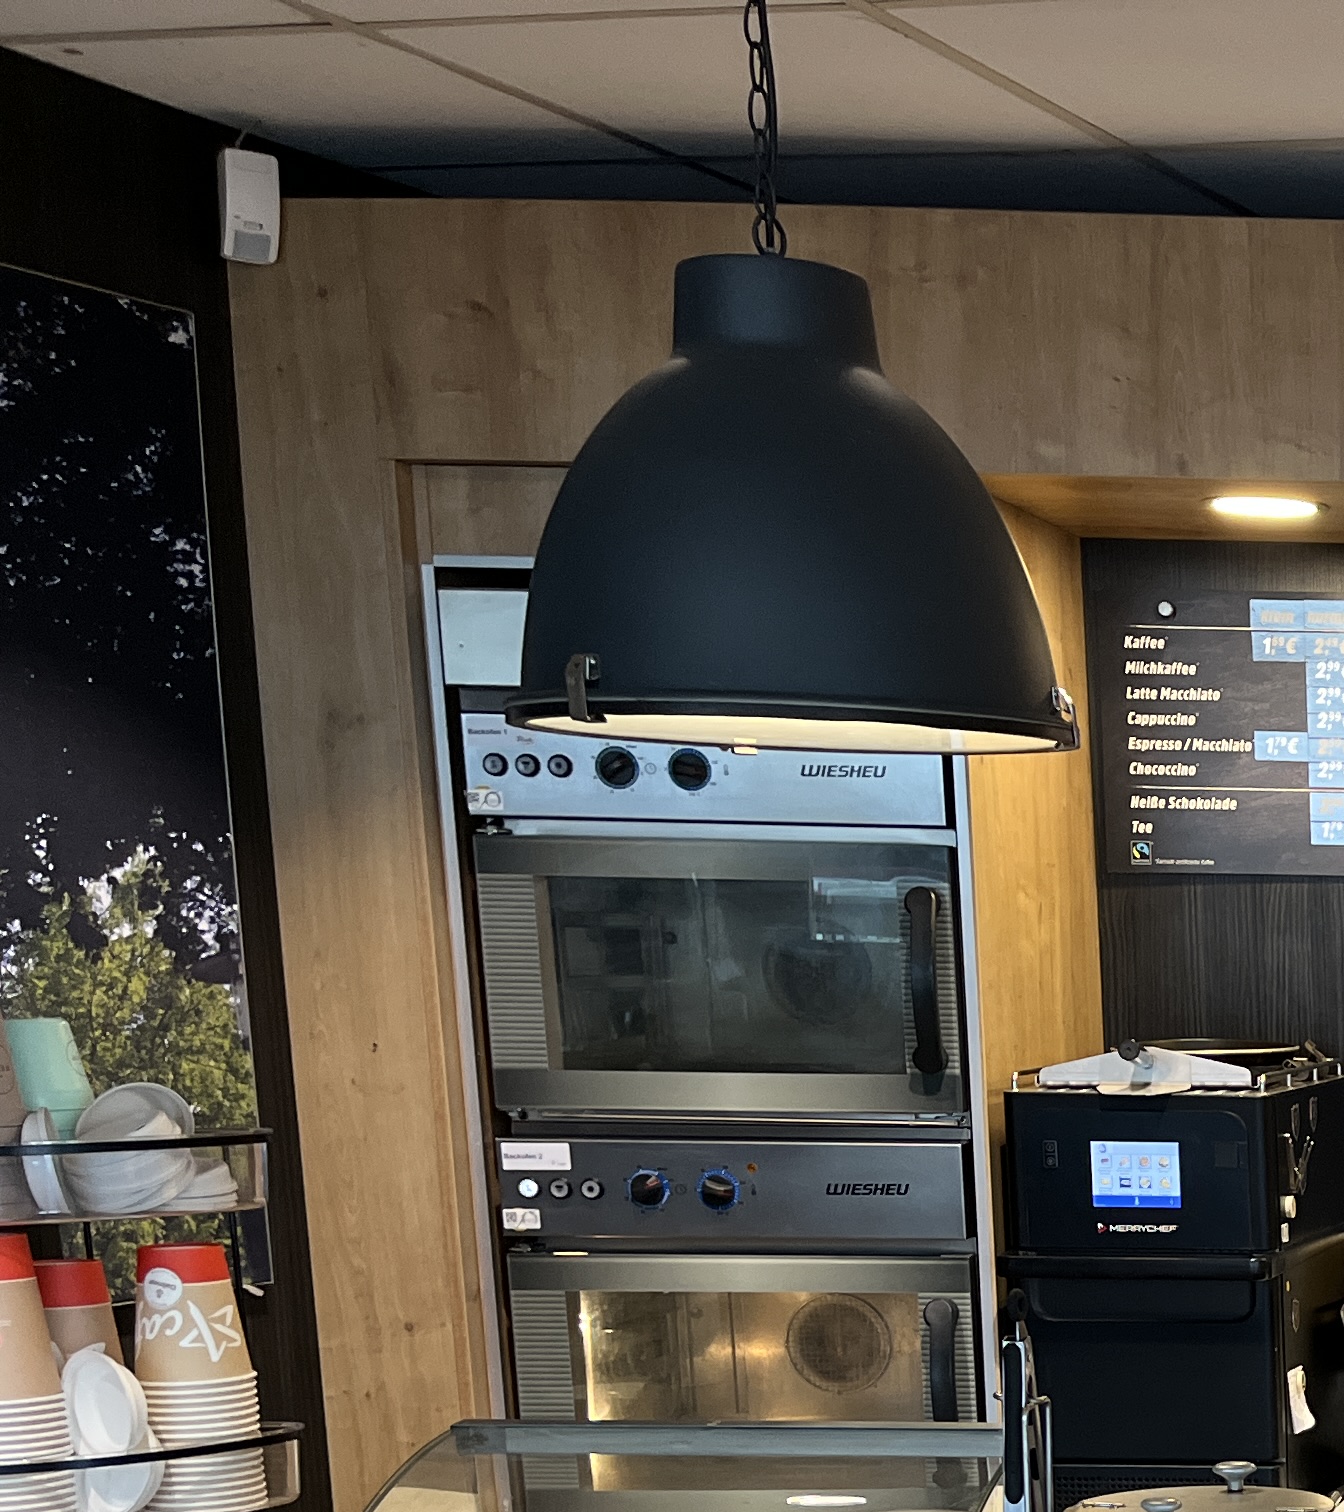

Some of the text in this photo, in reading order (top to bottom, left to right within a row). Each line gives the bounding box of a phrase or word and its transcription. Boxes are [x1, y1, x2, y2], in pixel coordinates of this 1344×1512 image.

[1123, 636, 1164, 651] Kaffee
[1125, 661, 1196, 676] Milchkaffee
[1126, 686, 1220, 701] Latte Macchiato
[1127, 712, 1196, 728] Cappuccino
[1128, 737, 1182, 754] Espresso
[1192, 737, 1252, 752] Macchiato
[800, 765, 886, 779] WIESHEU
[1129, 762, 1196, 776] Chococcino
[1130, 795, 1237, 811] Heiße Schokolade
[1132, 820, 1152, 834] Tee
[826, 1183, 909, 1196] WIESHEU
[1109, 1224, 1177, 1232] MERRYCHEF
